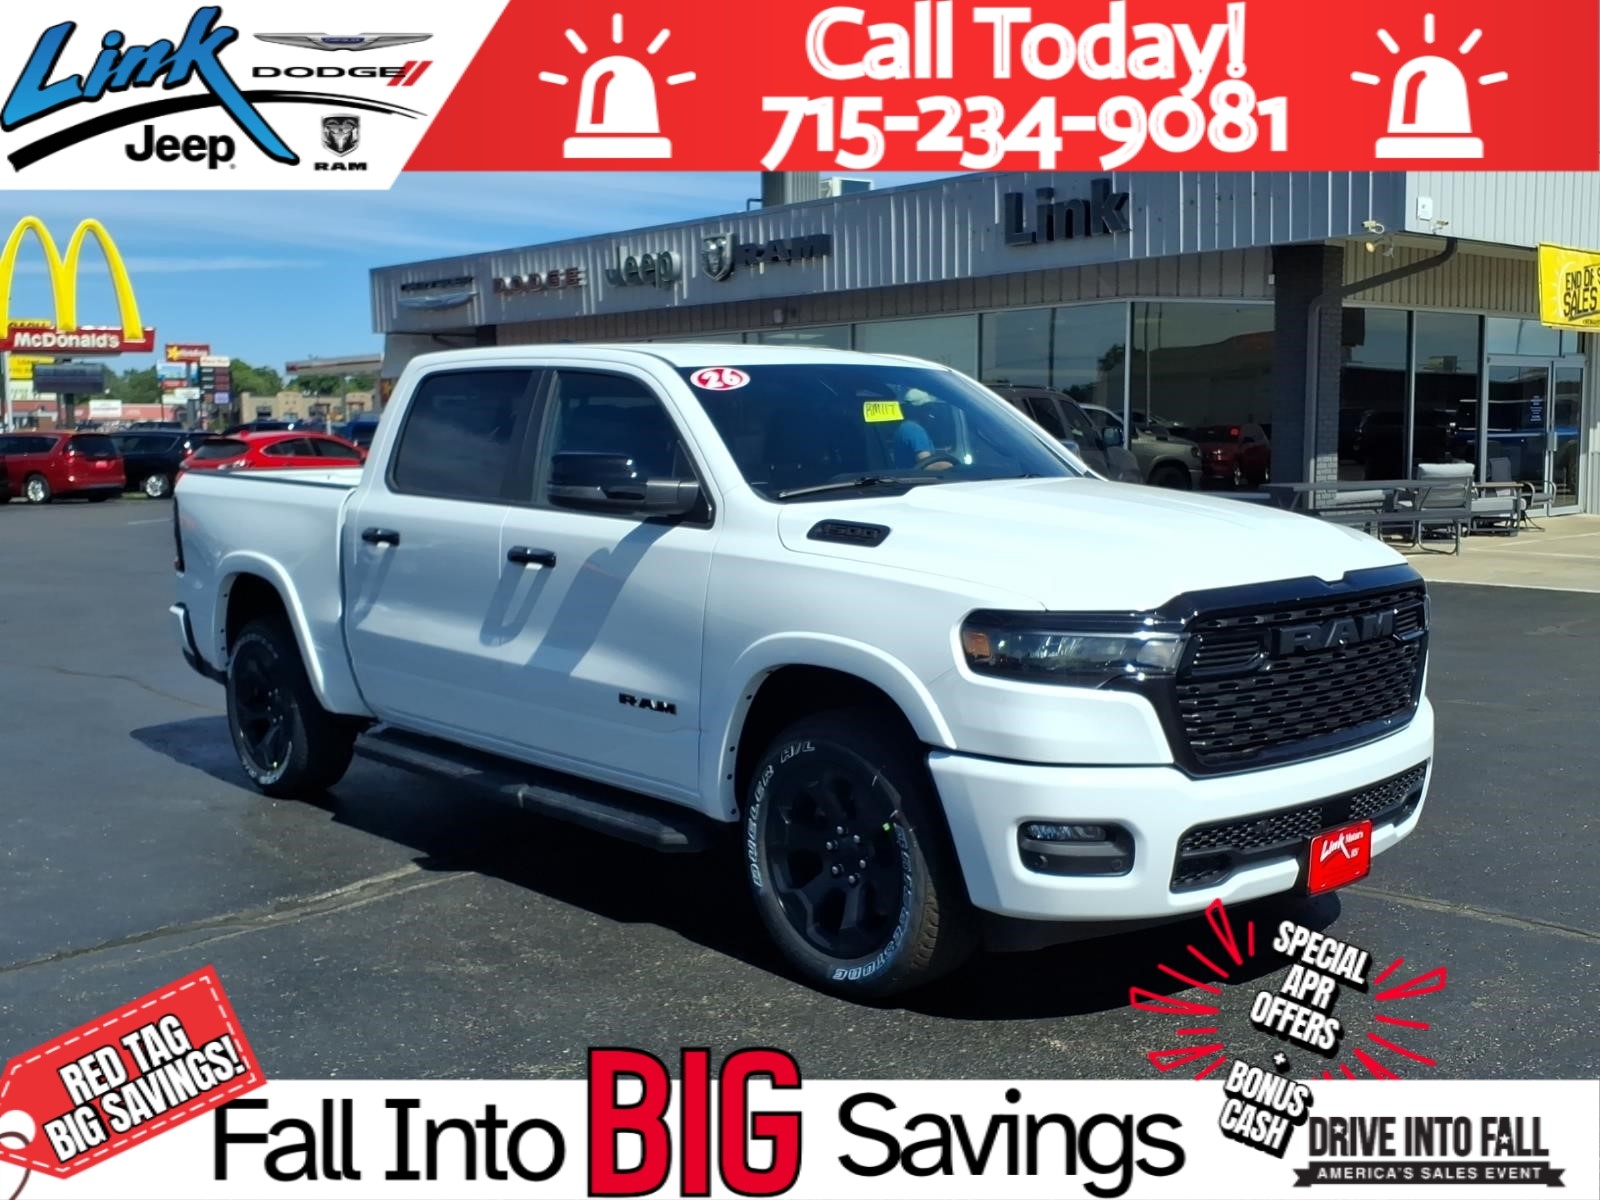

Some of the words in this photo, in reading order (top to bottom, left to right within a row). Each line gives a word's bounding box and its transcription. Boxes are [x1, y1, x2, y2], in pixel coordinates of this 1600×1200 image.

[1004, 178, 1131, 246] Link
[604, 244, 681, 289] Jeep
[1565, 271, 1582, 291] END
[494, 267, 586, 296] DODGE
[1563, 286, 1598, 317] SALES
[14, 331, 120, 348] McDonald's
[700, 368, 743, 390] 26
[1278, 609, 1397, 656] RAM
[618, 692, 677, 716] RAM
